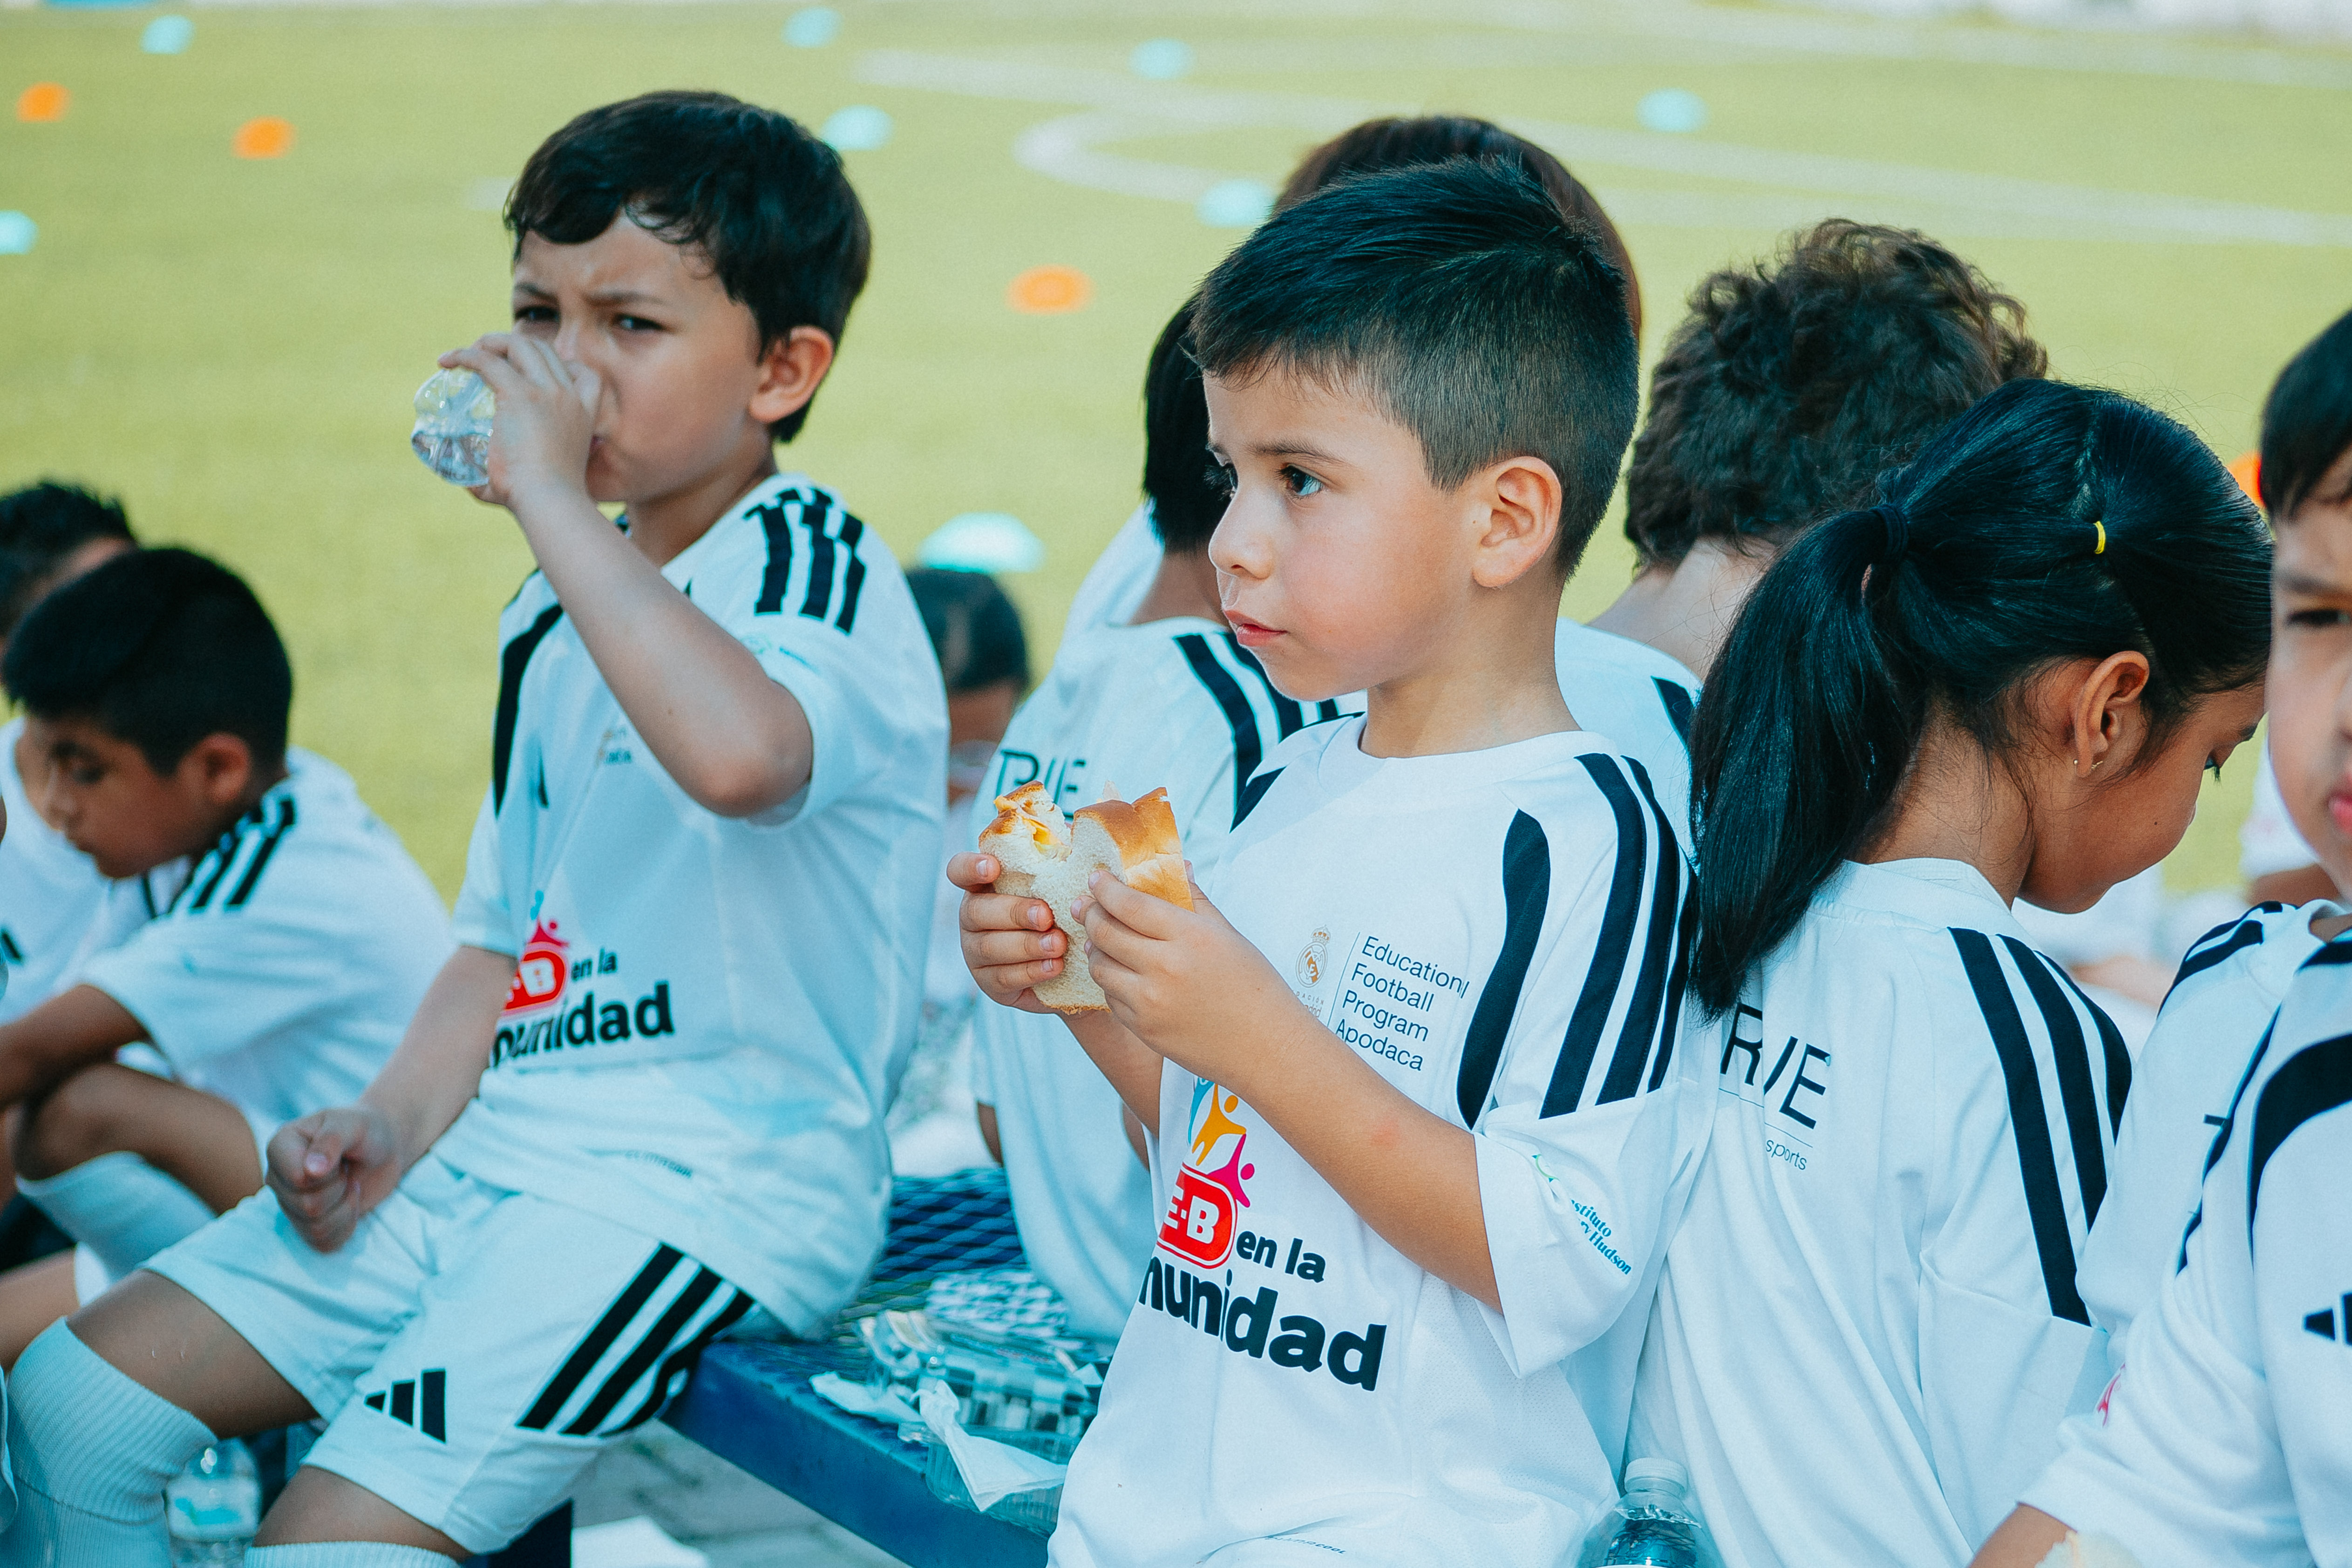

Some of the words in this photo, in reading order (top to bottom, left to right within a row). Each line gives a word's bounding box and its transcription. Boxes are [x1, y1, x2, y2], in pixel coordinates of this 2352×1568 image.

[571, 958, 592, 982] en
[597, 948, 618, 975] la
[1352, 963, 1434, 1012] Football
[1342, 990, 1429, 1041] Program
[1335, 1018, 1423, 1071] Apodaca
[1766, 1140, 1807, 1170] sports
[1571, 1199, 1611, 1237] stituto
[1236, 1230, 1277, 1269] en
[1285, 1237, 1326, 1283] la
[1589, 1230, 1631, 1275] Hudson
